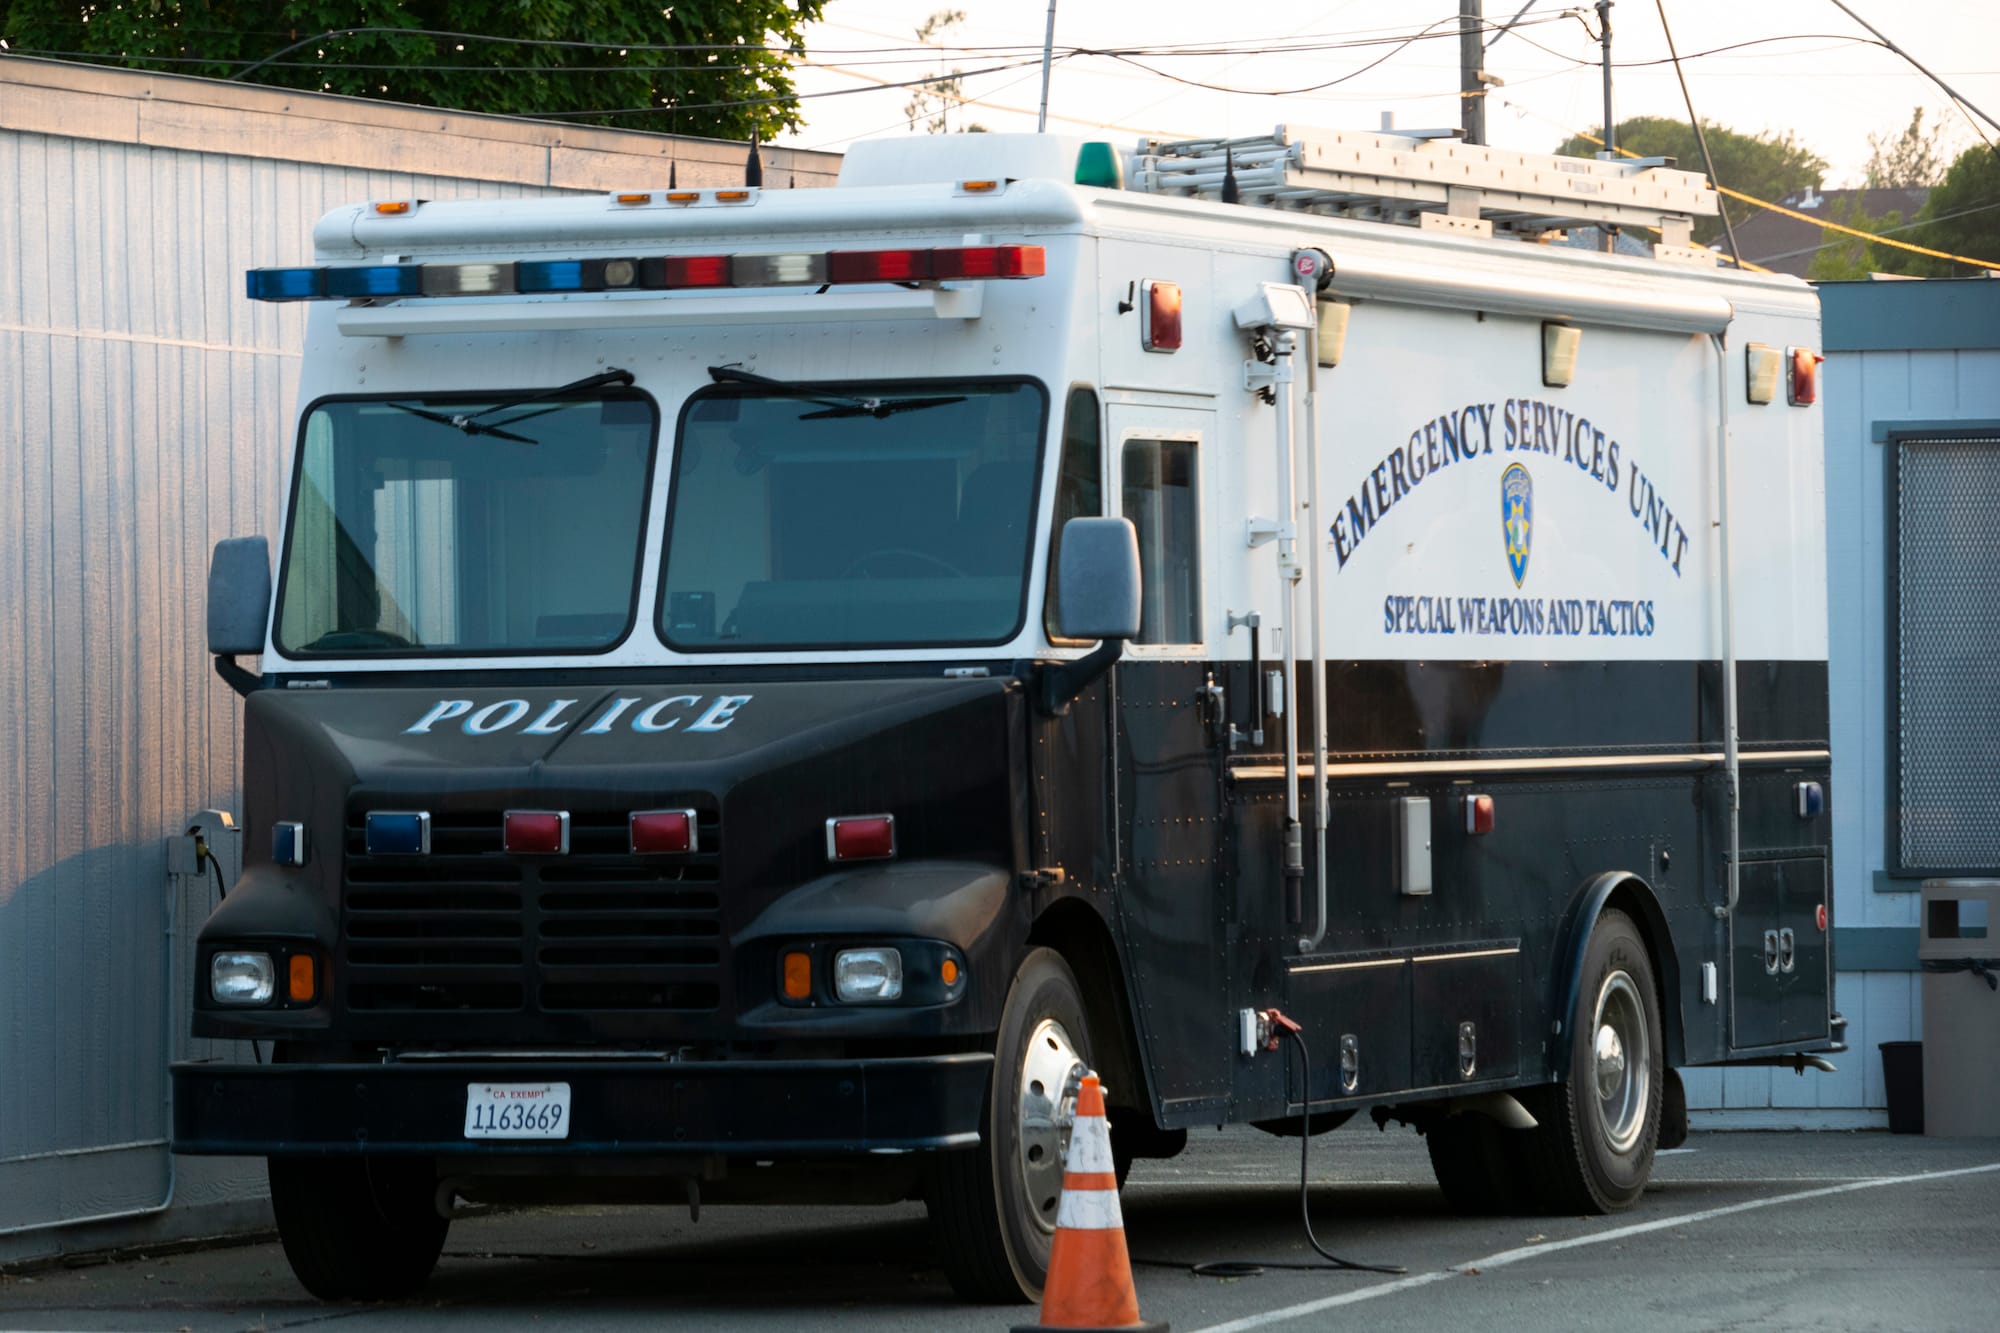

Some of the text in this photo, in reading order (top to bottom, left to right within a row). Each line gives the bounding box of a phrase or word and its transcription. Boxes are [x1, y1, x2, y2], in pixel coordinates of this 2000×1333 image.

[1329, 399, 1688, 578] EMERGENCY SERVICES UNIT
[1384, 595, 1655, 636] SPECIAL WEAPONS AND TACTICS
[401, 695, 753, 735] POLICE
[493, 1090, 545, 1099] CA EXEMPT
[472, 1103, 562, 1130] 1163669
